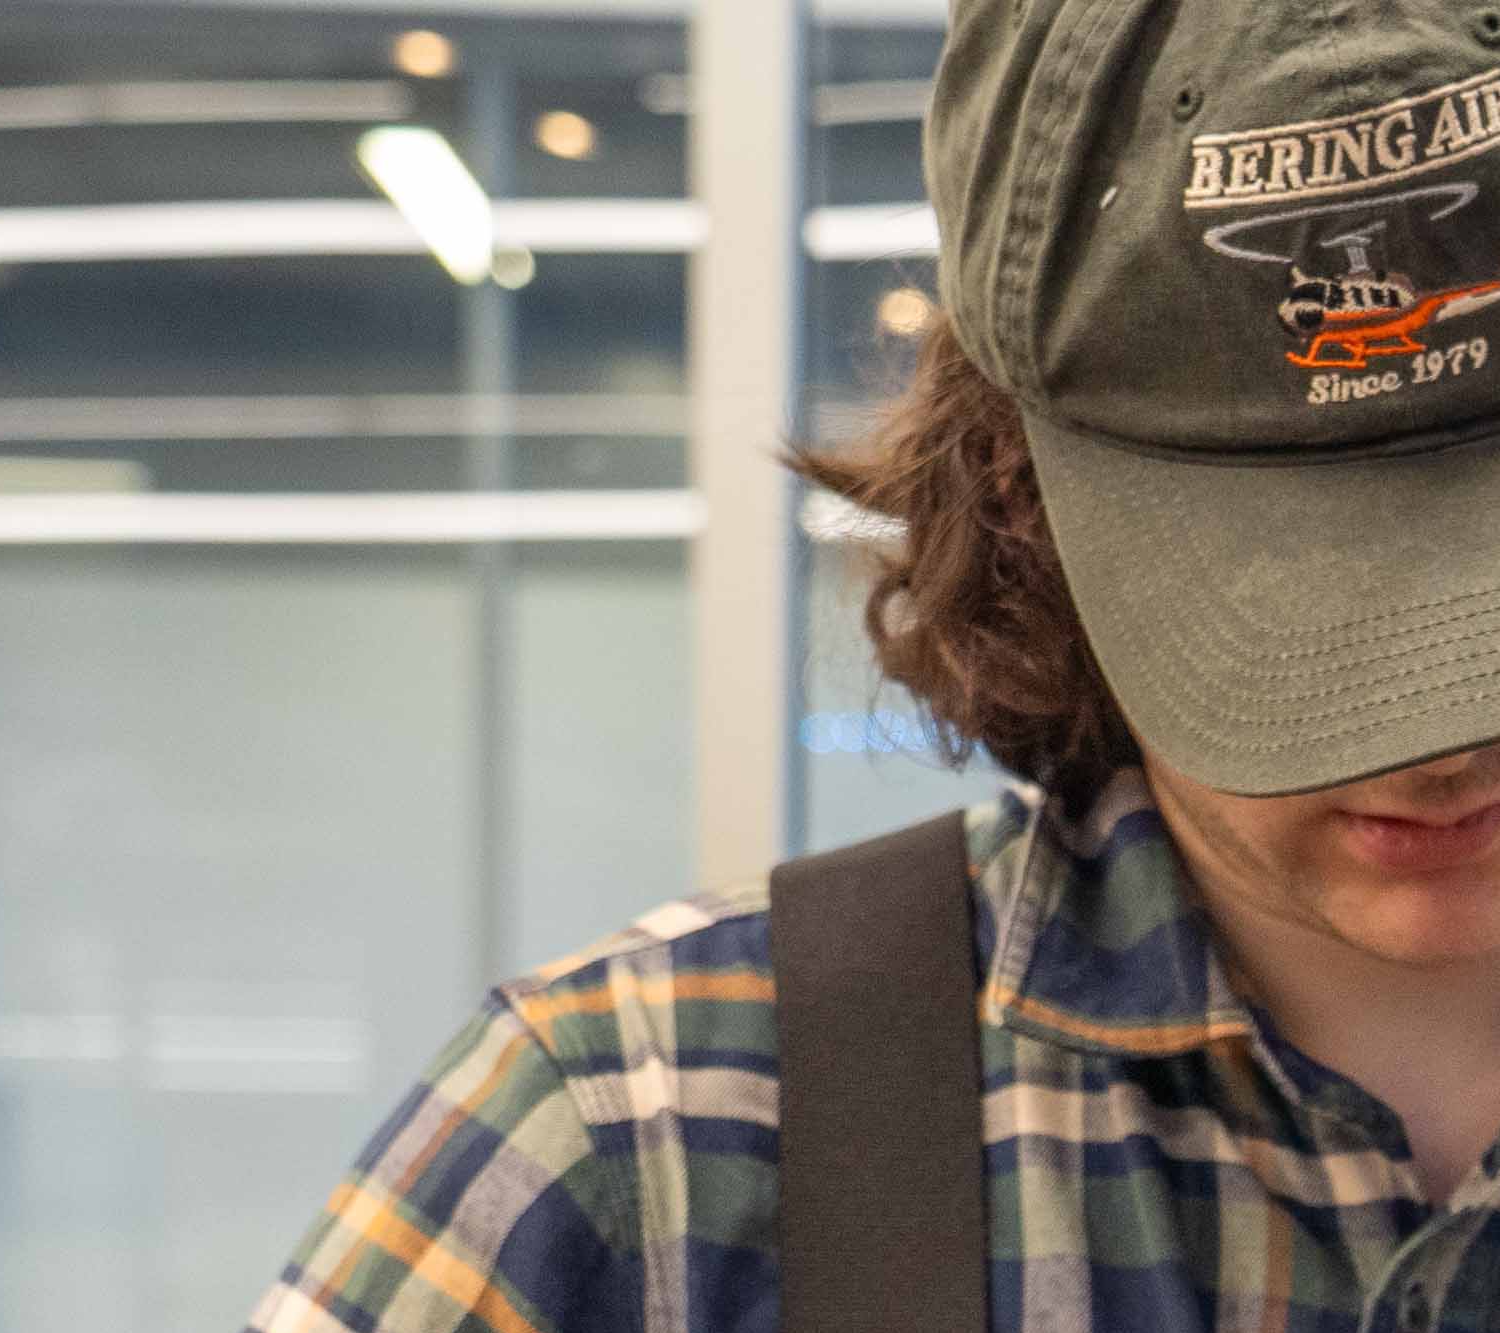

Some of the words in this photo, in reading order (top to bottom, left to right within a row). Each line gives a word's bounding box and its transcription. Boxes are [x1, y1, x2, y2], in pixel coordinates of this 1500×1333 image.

[1184, 110, 1414, 198] BERING
[1306, 369, 1401, 404] Since
[1411, 338, 1489, 386] 1979
